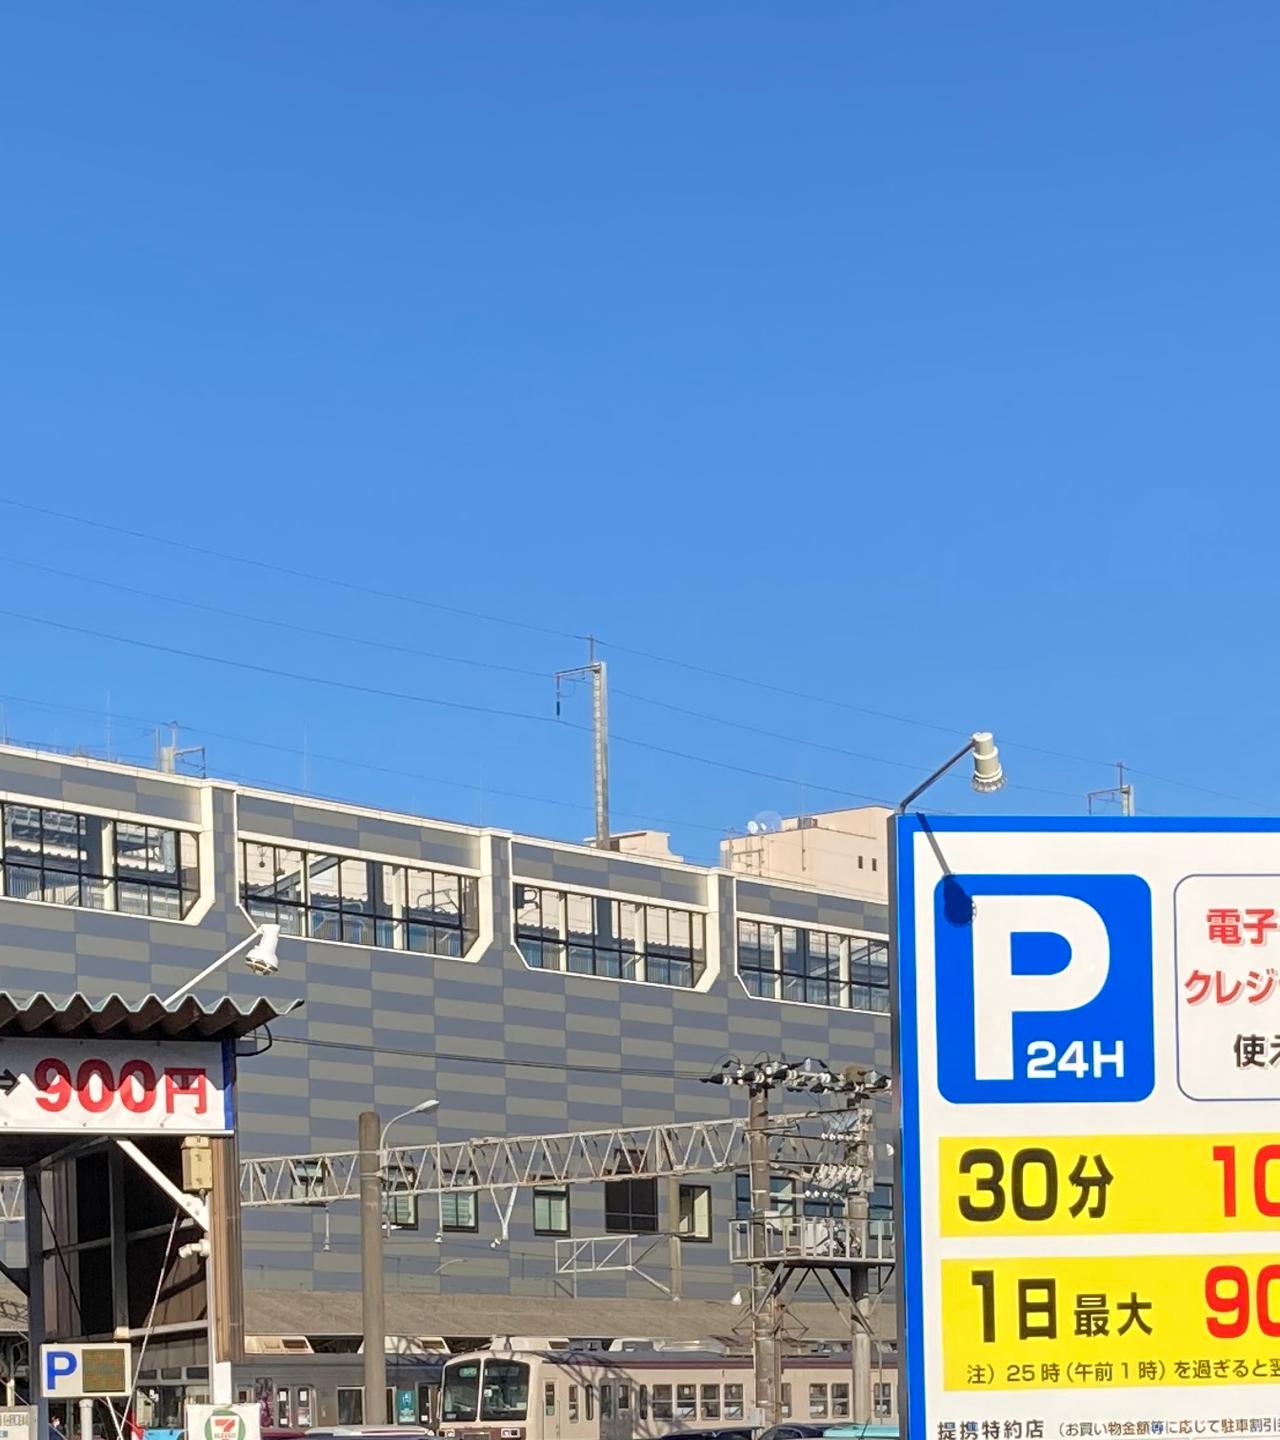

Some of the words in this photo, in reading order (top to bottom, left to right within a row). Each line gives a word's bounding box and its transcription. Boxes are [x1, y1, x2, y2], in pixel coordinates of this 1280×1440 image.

[971, 894, 1110, 1080] P
[1027, 1040, 1124, 1078] 24H
[34, 1057, 209, 1115] 900円
[958, 1147, 1113, 1222] 30分
[47, 1351, 77, 1390] P
[937, 1420, 1044, 1440] 提携特約店
